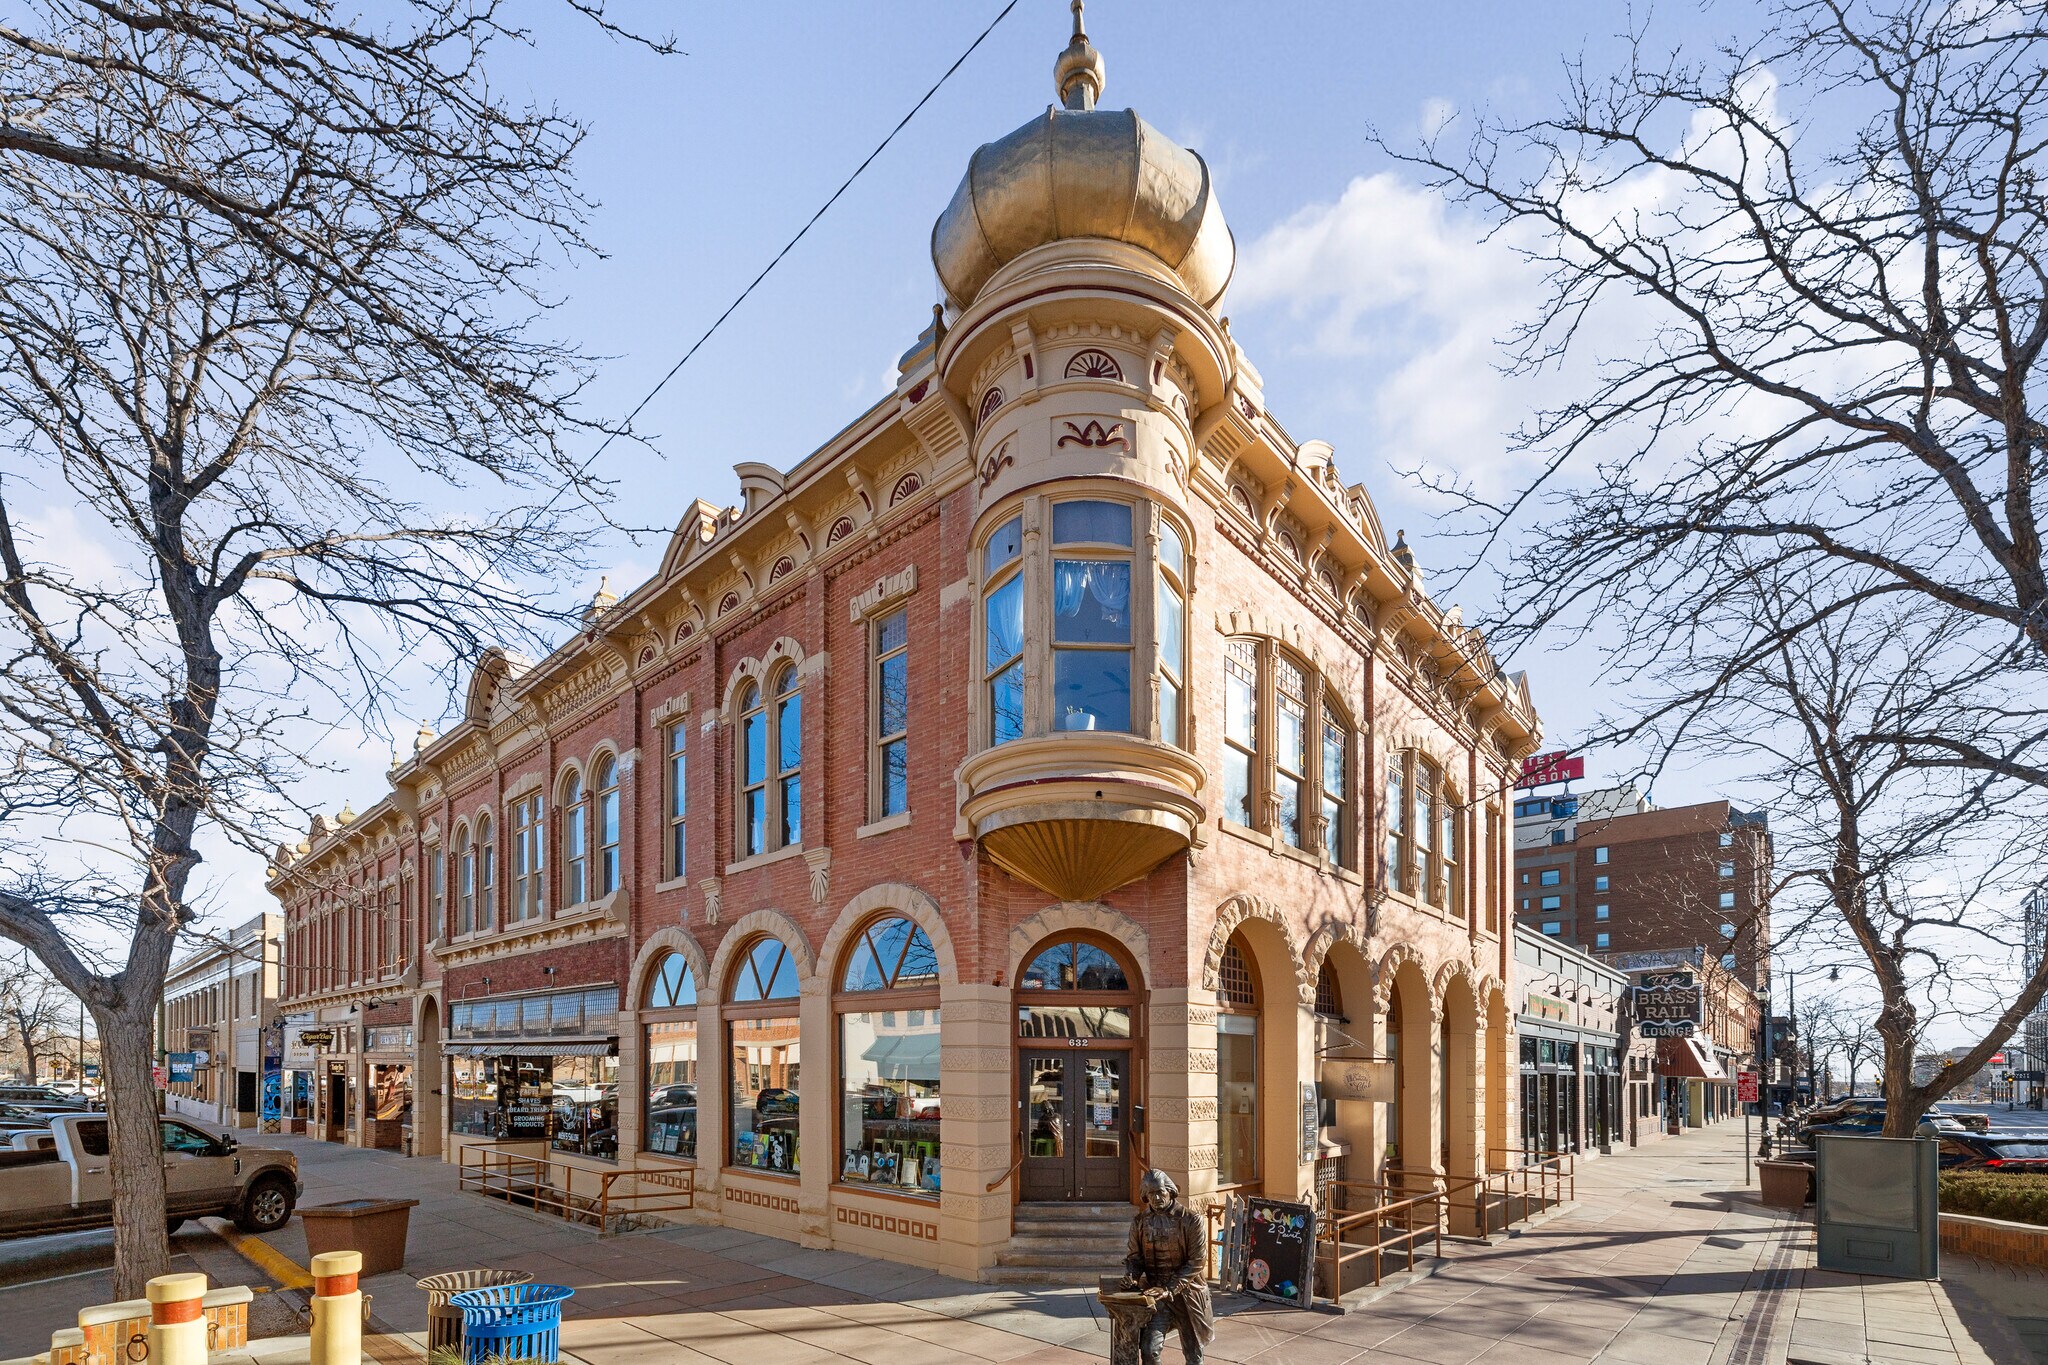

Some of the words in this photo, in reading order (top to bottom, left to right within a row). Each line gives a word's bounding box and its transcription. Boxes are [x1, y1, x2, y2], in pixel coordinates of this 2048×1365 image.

[1648, 973, 1685, 986] The
[1637, 991, 1697, 1005] BRASS
[1644, 1006, 1691, 1019] RAIL
[1643, 1026, 1693, 1037] LOUNGE
[302, 1032, 319, 1043] Cigar
[1068, 1039, 1089, 1047] 632
[1267, 1223, 1276, 1234] 2
